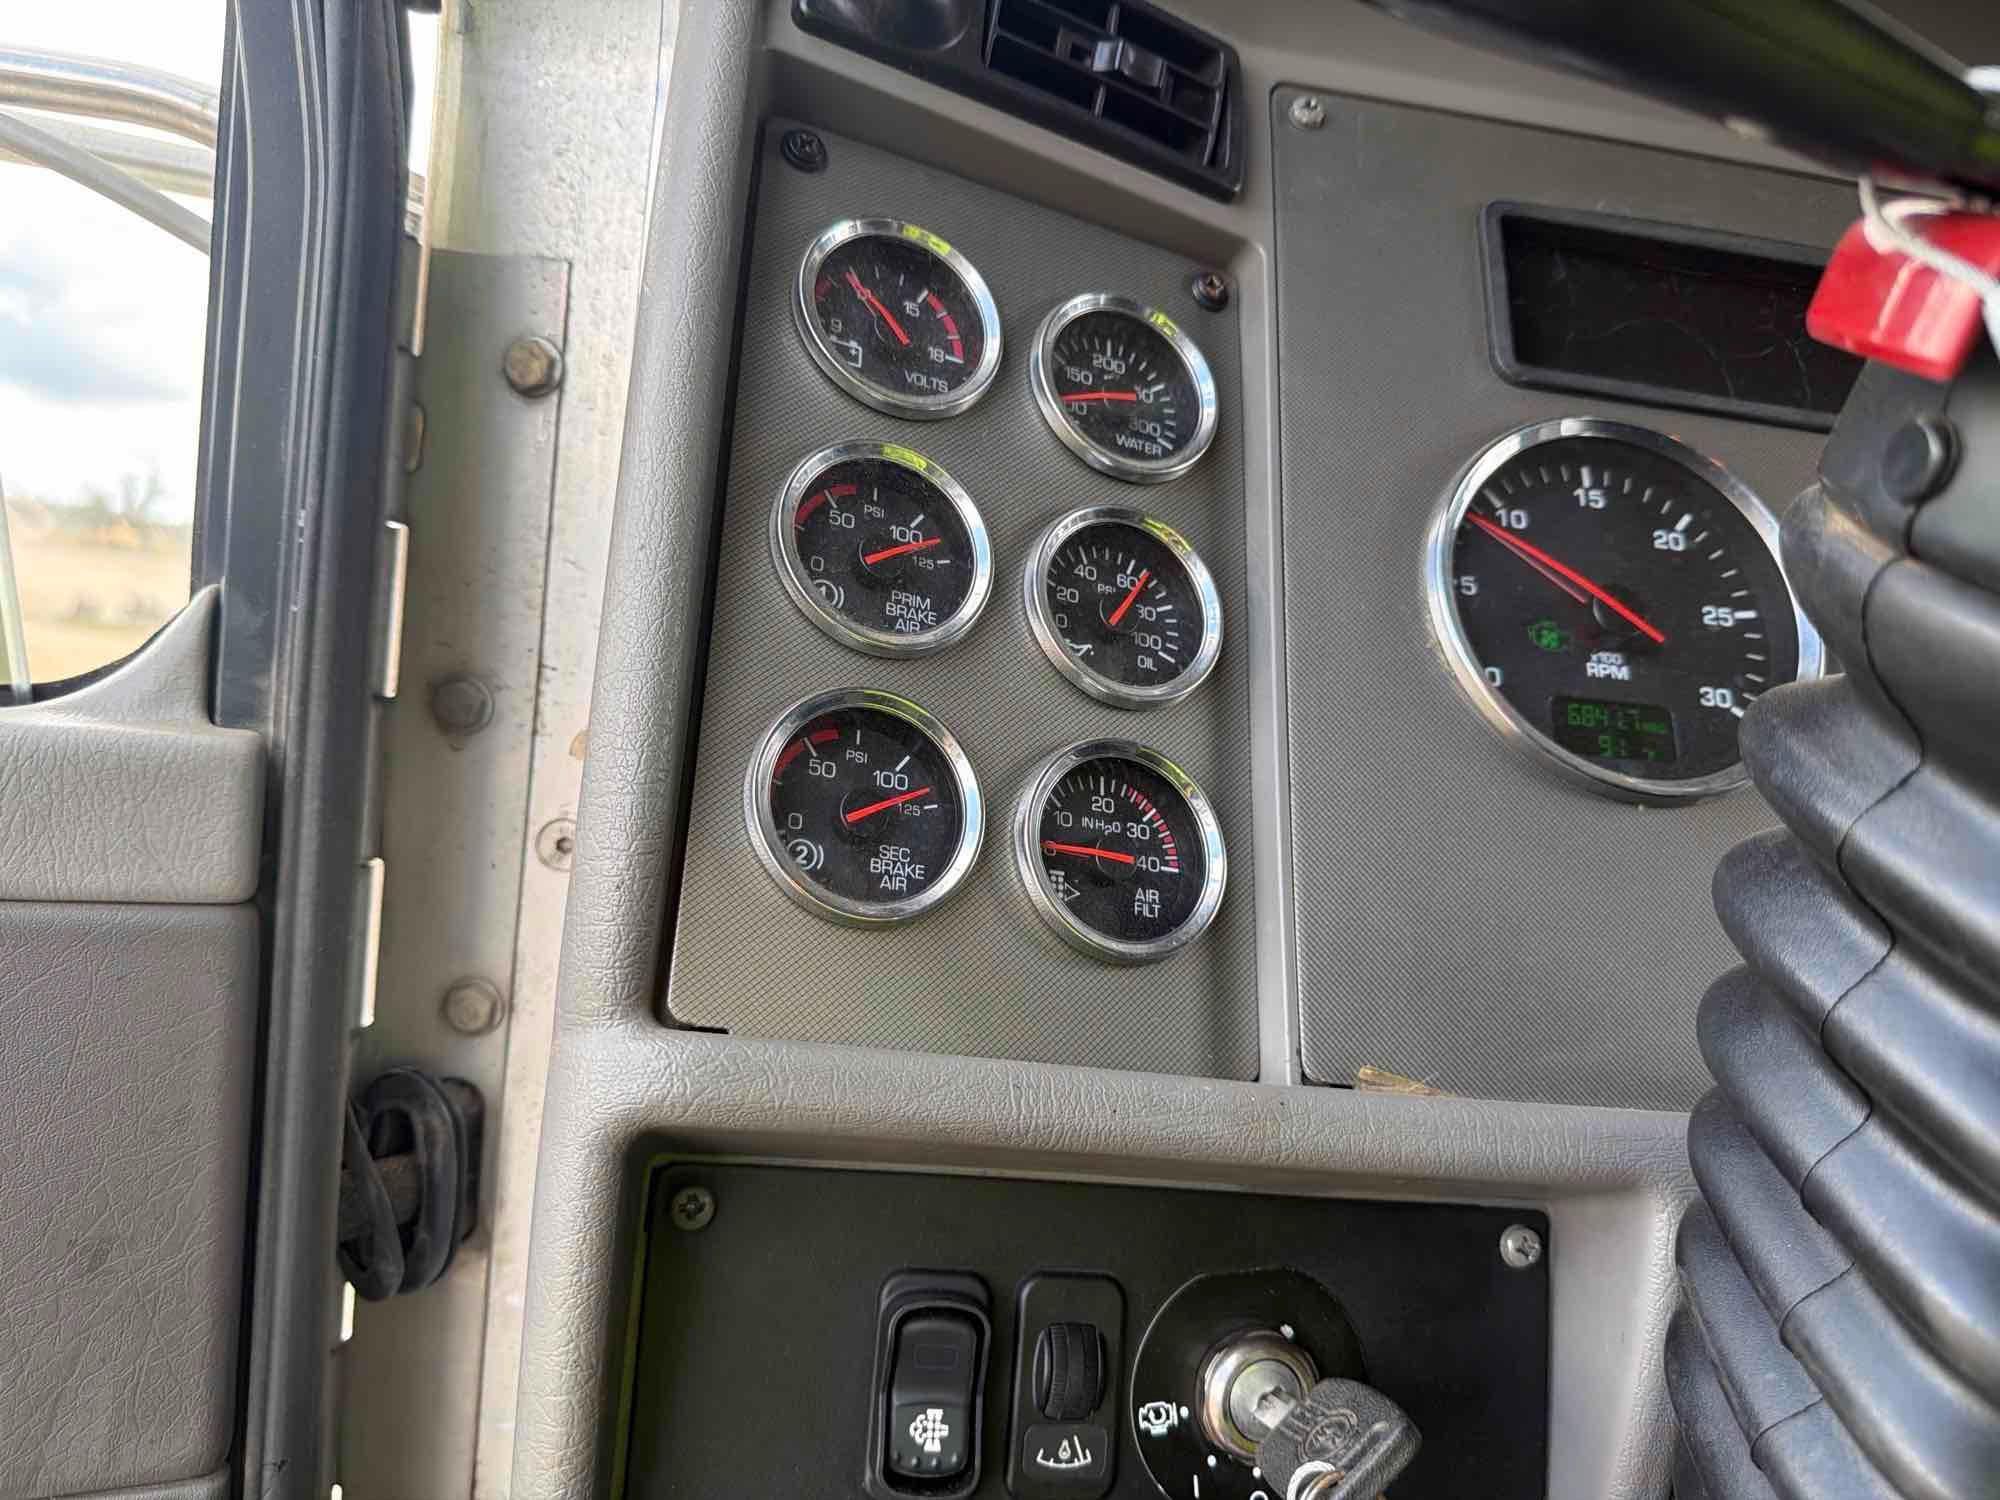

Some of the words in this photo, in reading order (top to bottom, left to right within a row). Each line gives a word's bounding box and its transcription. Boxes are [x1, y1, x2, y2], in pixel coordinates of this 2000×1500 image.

[904, 301, 920, 318] 15
[928, 346, 945, 364] 18
[1092, 353, 1126, 375] 200
[904, 370, 949, 393] VOLTS
[1065, 366, 1093, 386] 150
[1115, 433, 1162, 457] WATER
[1573, 487, 1606, 509] 15
[828, 510, 856, 529] 50
[864, 504, 885, 519] PSI
[1496, 508, 1529, 530] 10
[889, 525, 923, 544] 100
[1652, 530, 1686, 552] 20
[810, 555, 825, 572] 0
[911, 555, 935, 570] 125
[1073, 565, 1097, 581] 40
[1116, 573, 1139, 590] 60
[1056, 585, 1080, 604] 20
[1460, 576, 1478, 596] 5
[891, 590, 931, 611] PRIM
[885, 602, 937, 626] BRAKE
[1055, 613, 1068, 629] 0
[1701, 605, 1735, 627] 25
[895, 619, 921, 634] AIR
[1131, 630, 1163, 651] 100
[1137, 655, 1158, 672] OIL
[1586, 662, 1631, 681] RPM
[1484, 667, 1503, 688] 0
[1699, 687, 1733, 708] 30
[845, 749, 869, 765] PSI
[808, 758, 837, 779] 50
[872, 769, 909, 791] 100
[898, 802, 921, 817] 125
[1091, 796, 1115, 814] 20
[787, 812, 804, 831] 0
[1054, 810, 1073, 828] 10
[1126, 822, 1150, 841] 30
[879, 844, 911, 862] SEC
[869, 857, 926, 881] BRAKE
[1137, 855, 1160, 873] 40
[879, 874, 908, 892] AIR
[1134, 887, 1160, 903] AIR
[1134, 901, 1160, 918] FILT
